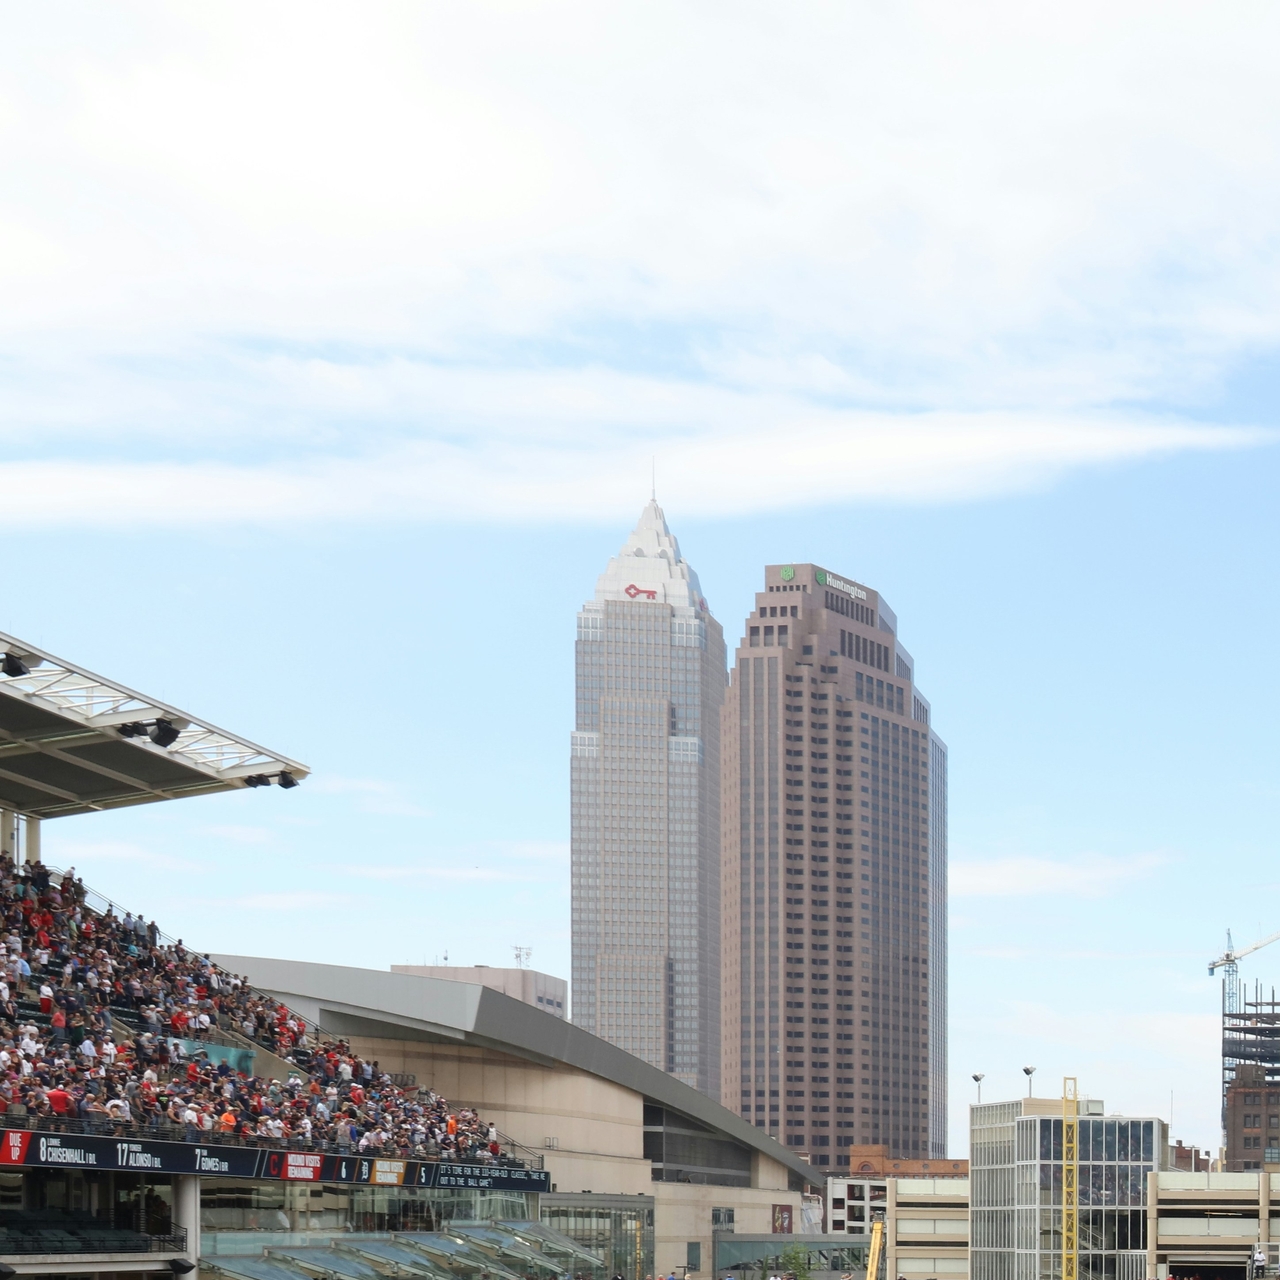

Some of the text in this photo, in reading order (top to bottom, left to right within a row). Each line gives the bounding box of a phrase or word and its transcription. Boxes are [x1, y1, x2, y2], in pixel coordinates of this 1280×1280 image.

[826, 573, 867, 600] Huntington
[9, 1132, 22, 1146] DUE
[11, 1147, 20, 1160] UP
[40, 1137, 85, 1163] 8 CHISENHALL
[117, 1143, 151, 1167] 17 ALONSO
[195, 1149, 219, 1170] 7 GOMES
[287, 1154, 321, 1167] MOUND VISITS
[375, 1160, 404, 1173] MOUND VISITS
[287, 1167, 314, 1179] REMAINING
[341, 1162, 347, 1179] 6
[421, 1167, 426, 1183] 5
[440, 1165, 451, 1174] IT'S
[472, 1168, 480, 1176] THE
[440, 1176, 448, 1185] OUT
[468, 1178, 477, 1186] BALL
